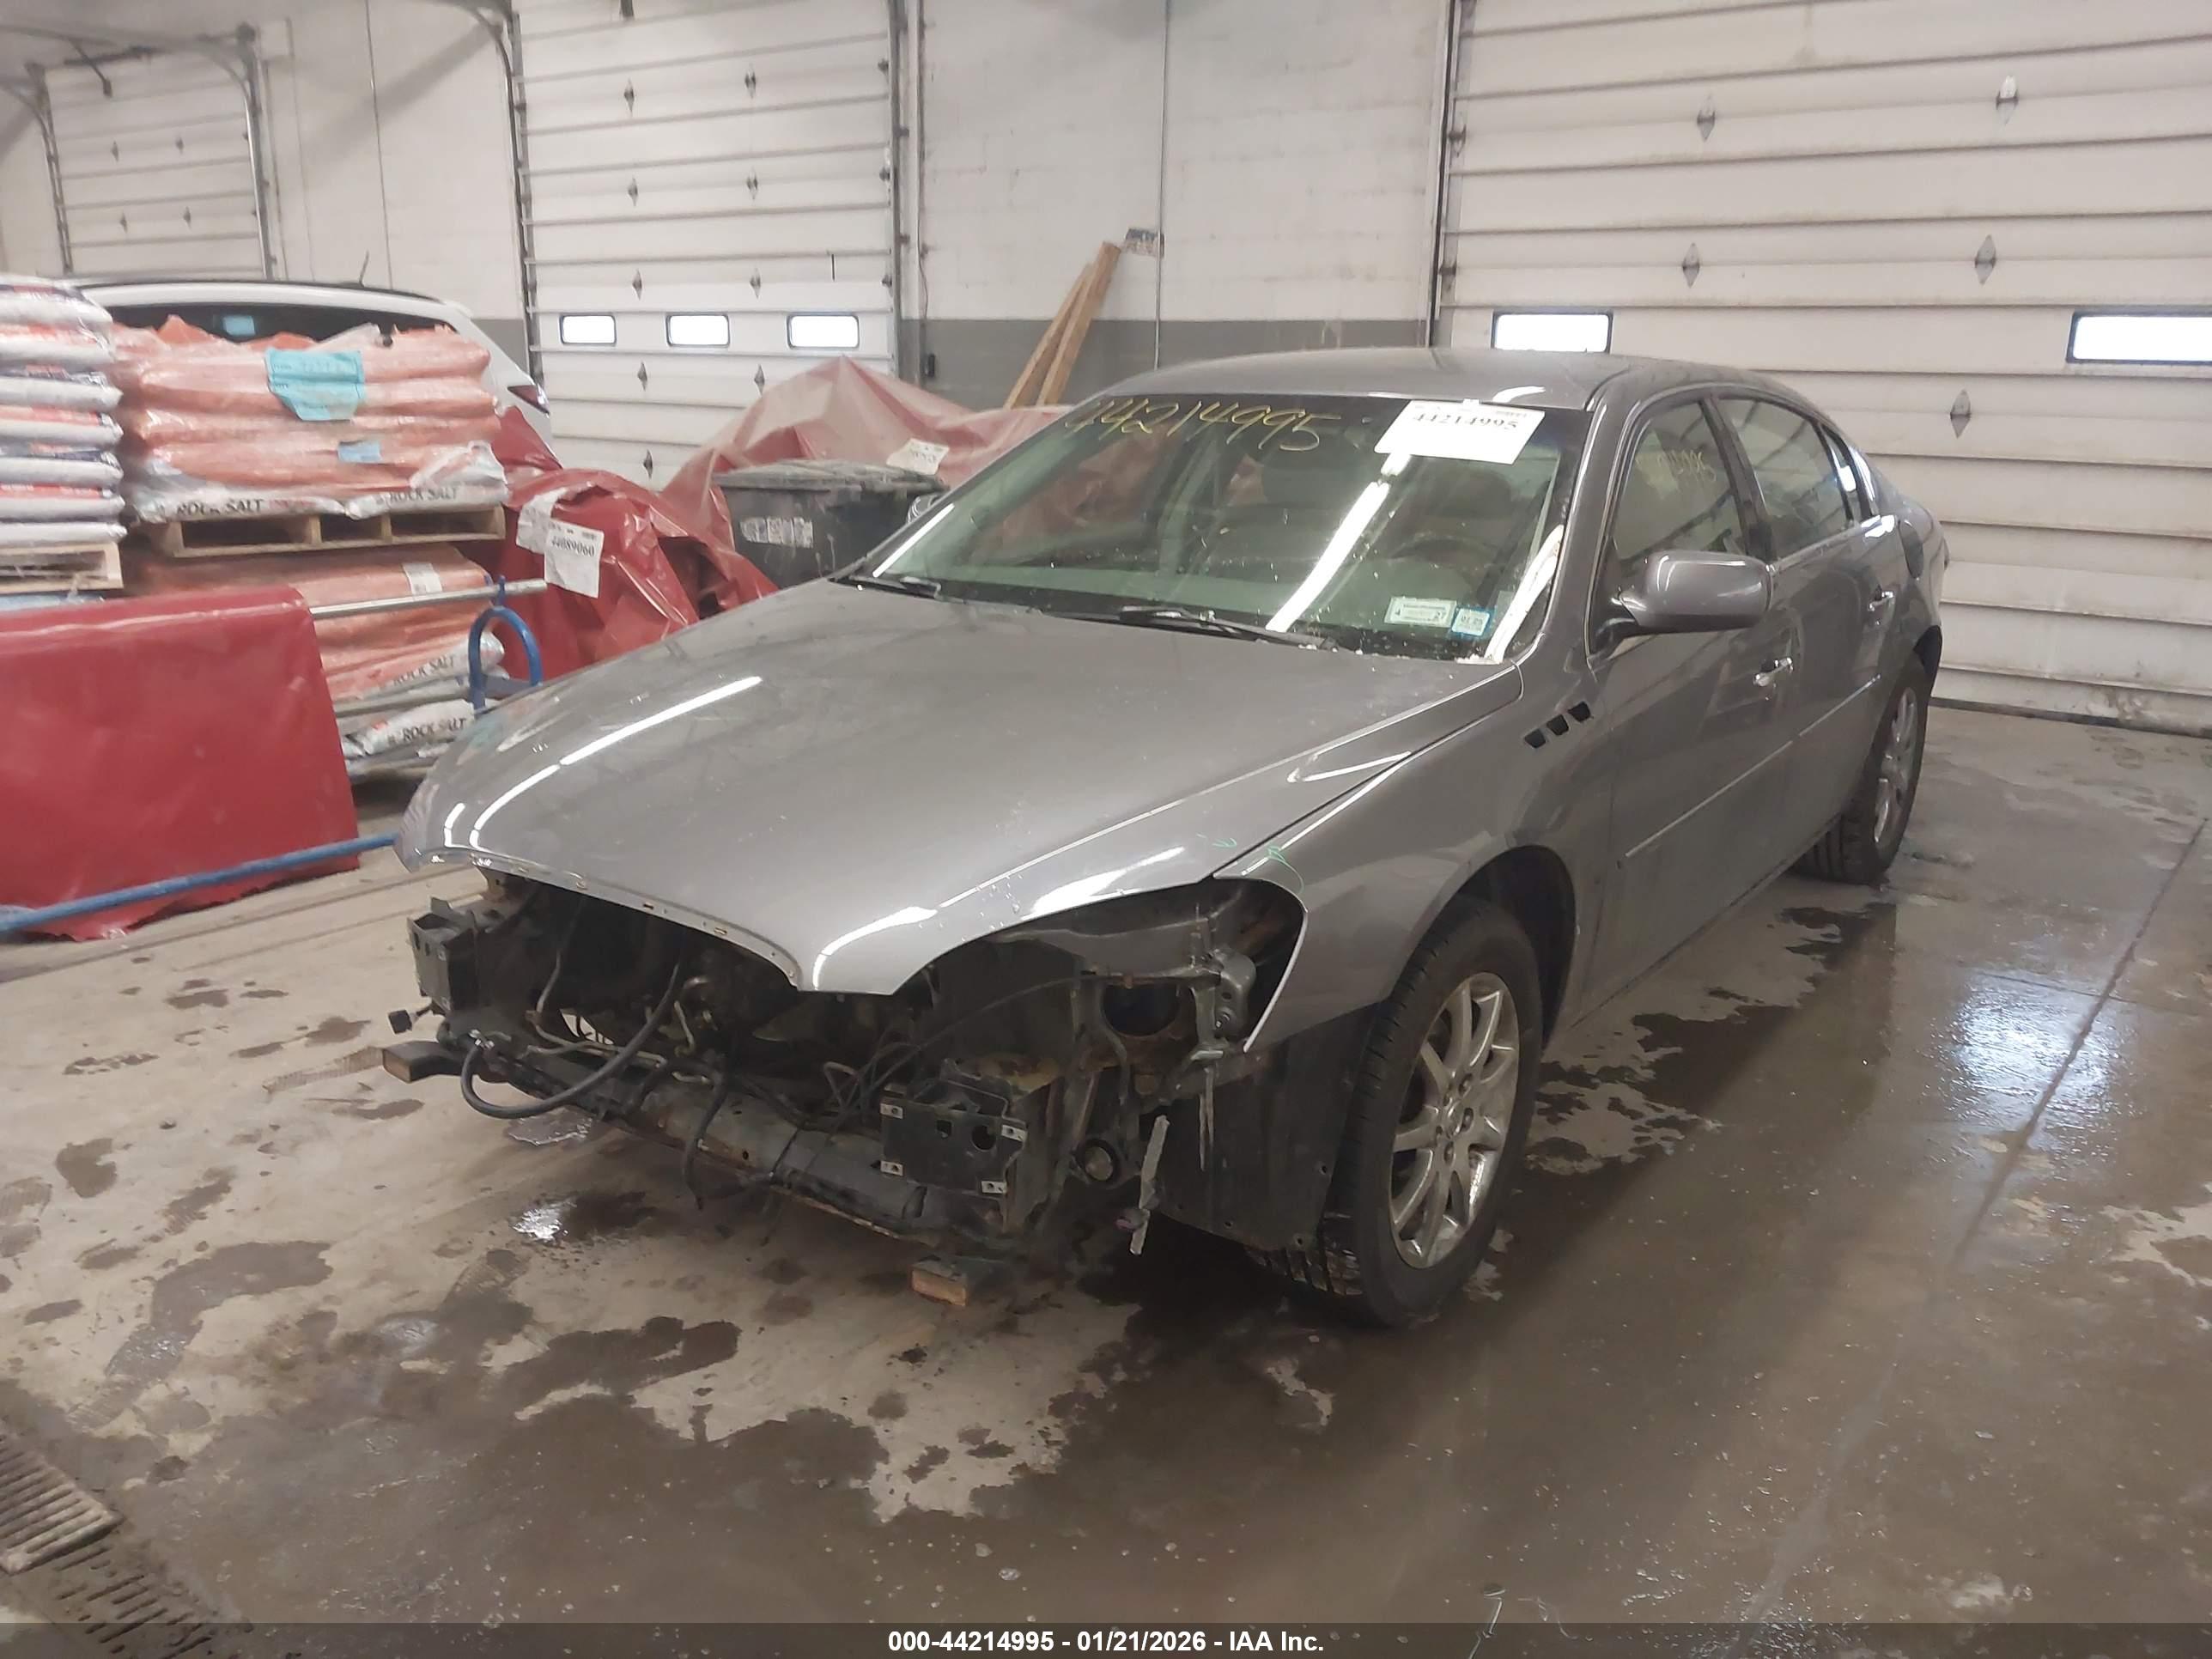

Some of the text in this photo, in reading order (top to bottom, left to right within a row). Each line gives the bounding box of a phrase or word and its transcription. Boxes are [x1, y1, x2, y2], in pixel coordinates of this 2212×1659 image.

[1064, 398, 1342, 452] 44214995
[1412, 413, 1519, 430] 44214995
[428, 486, 458, 501] SALT
[226, 498, 264, 514] SALT
[403, 721, 436, 742] ROCK
